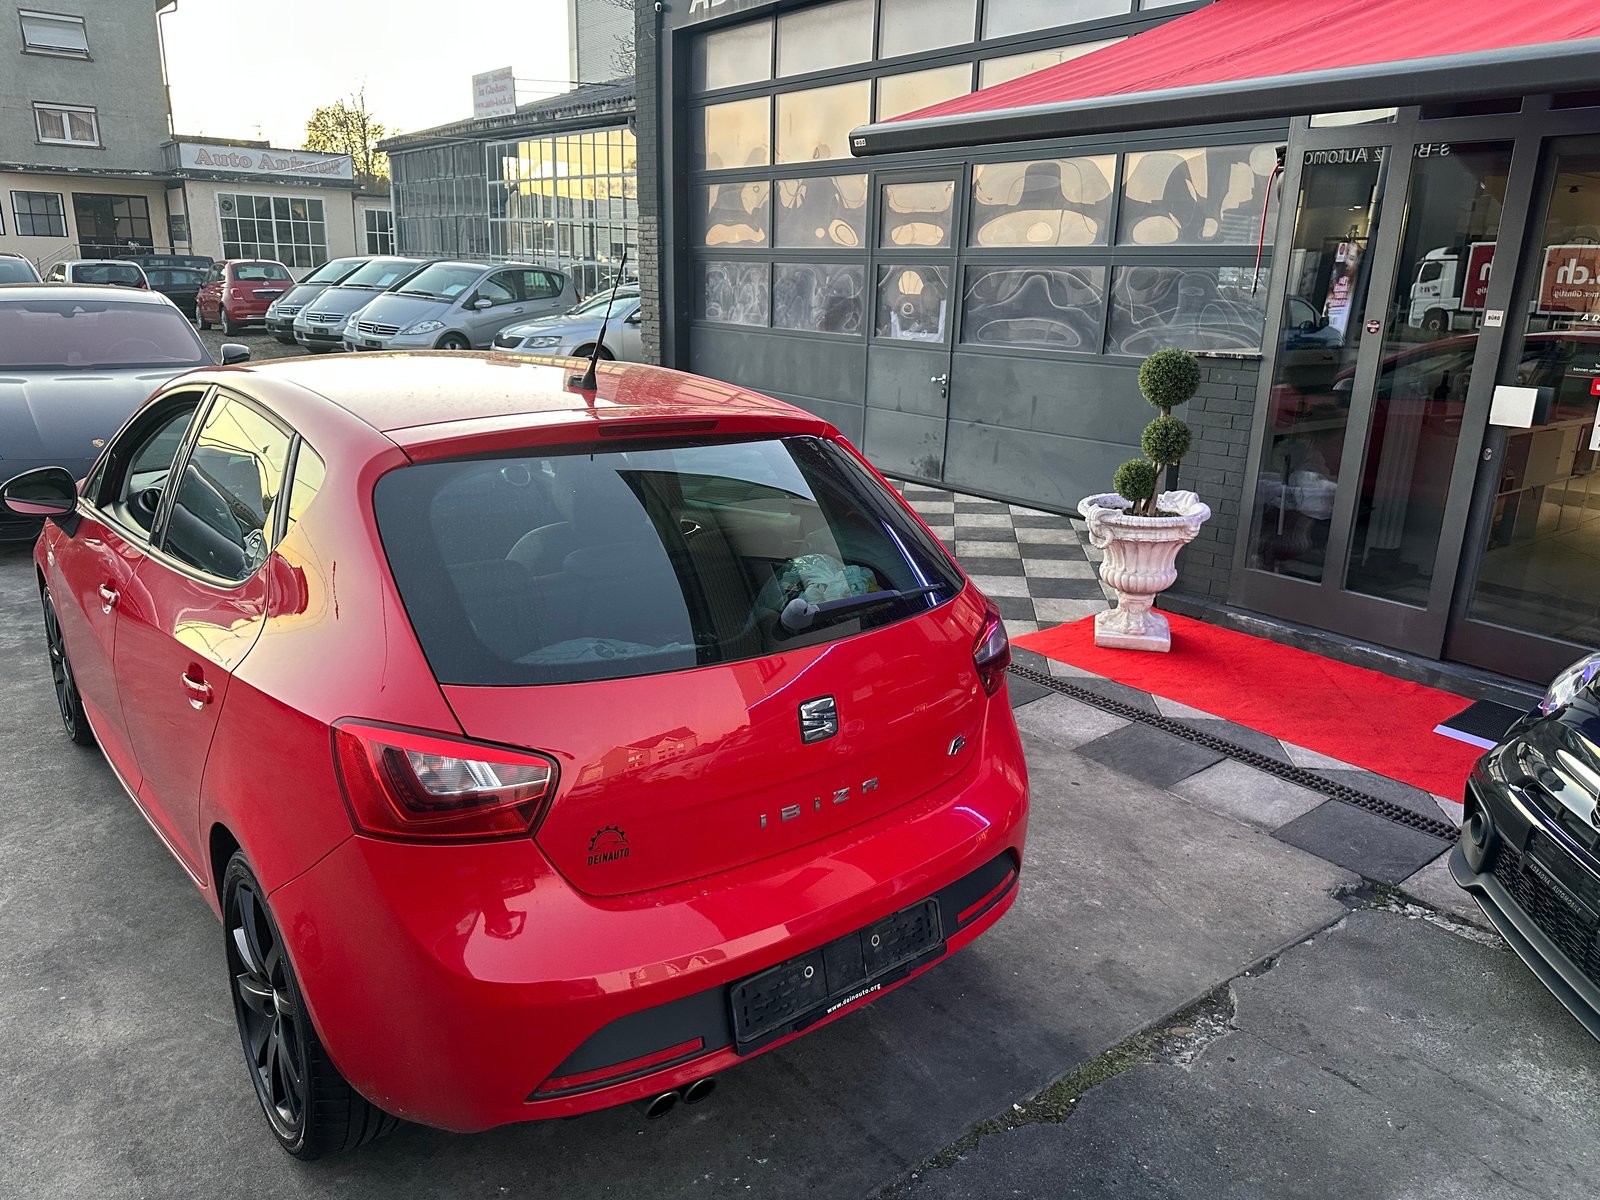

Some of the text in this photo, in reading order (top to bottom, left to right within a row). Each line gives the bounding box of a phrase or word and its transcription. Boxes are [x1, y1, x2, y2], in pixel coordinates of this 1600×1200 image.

[195, 148, 341, 175] Auto Ankauf
[1581, 313, 1600, 322] AD
[759, 777, 878, 829] IBIZA
[587, 847, 630, 866] DEINAUTO
[1529, 863, 1581, 914] ADRAGNA AUTOMOBILE
[826, 983, 881, 1014] www.deinauto.org
